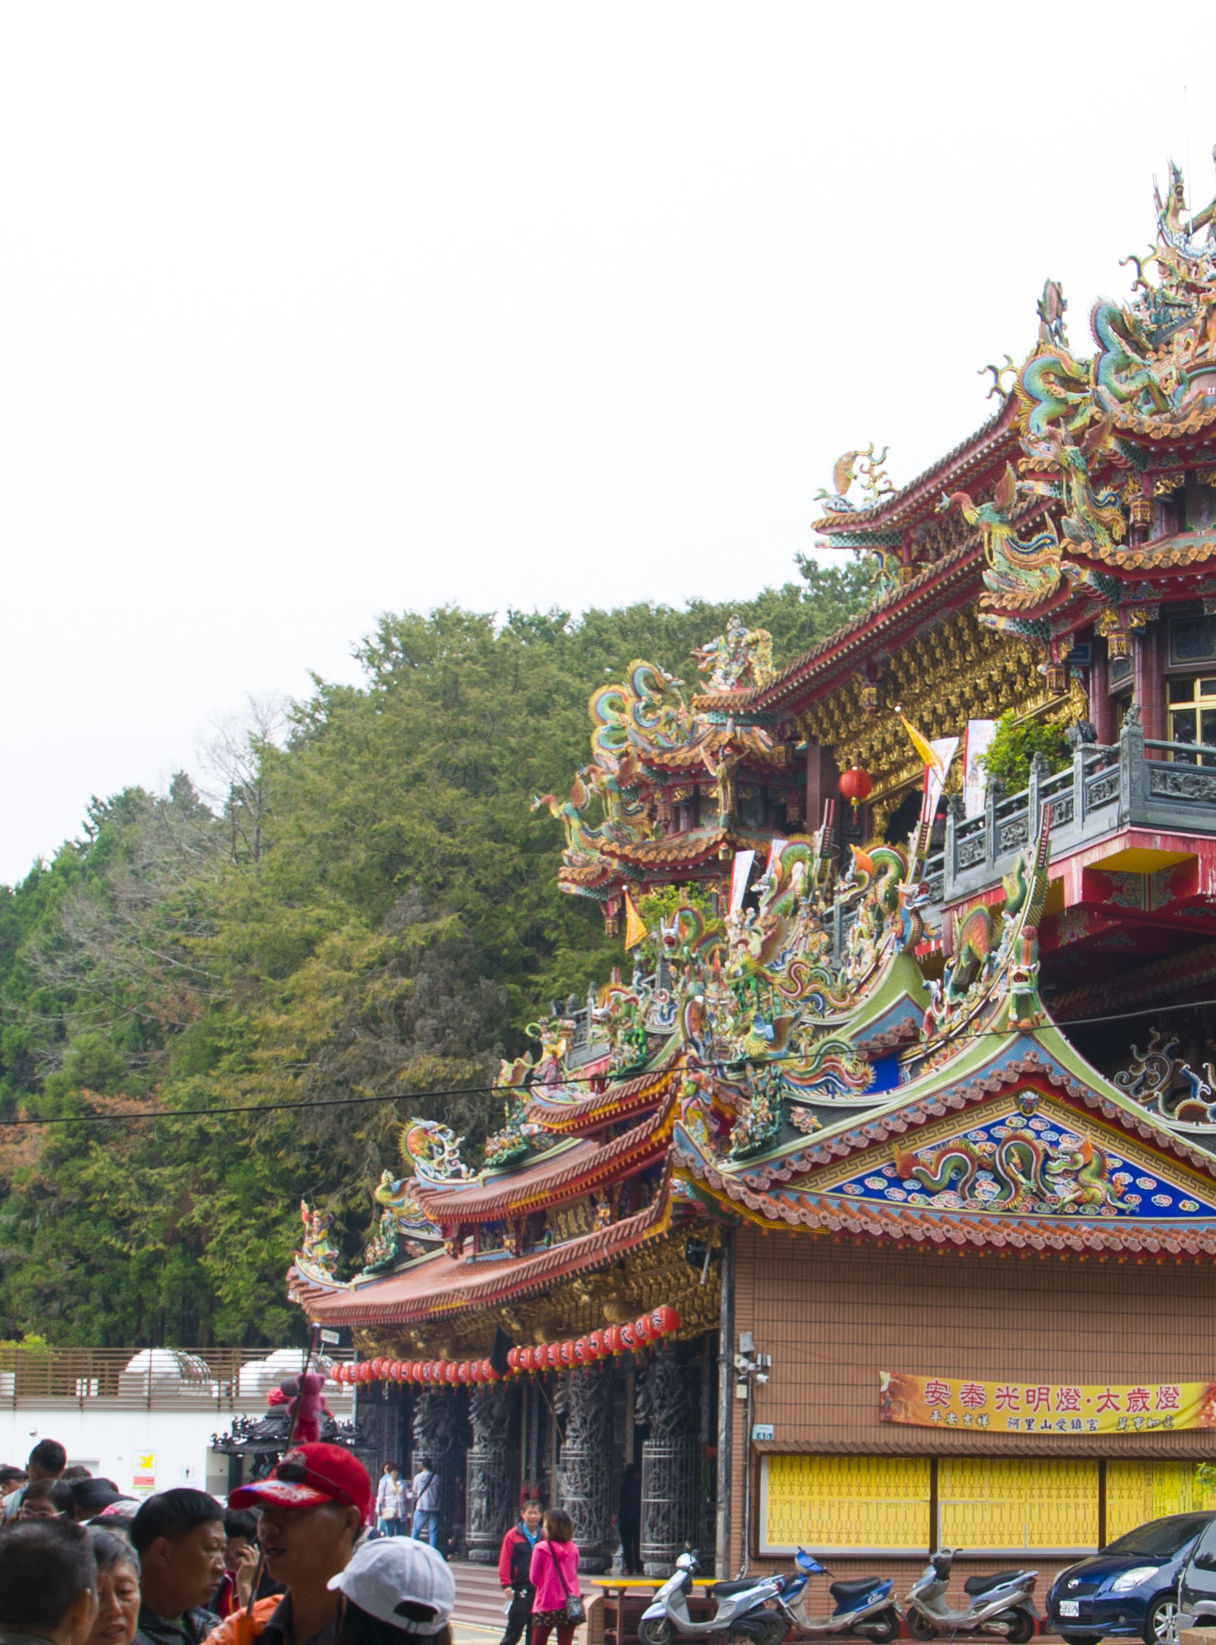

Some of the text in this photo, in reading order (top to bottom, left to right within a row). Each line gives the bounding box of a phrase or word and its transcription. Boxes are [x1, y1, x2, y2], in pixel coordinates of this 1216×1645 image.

[929, 1410, 990, 1430] 平安吉祥
[1008, 1416, 1099, 1432] 阿里山受鎮宮
